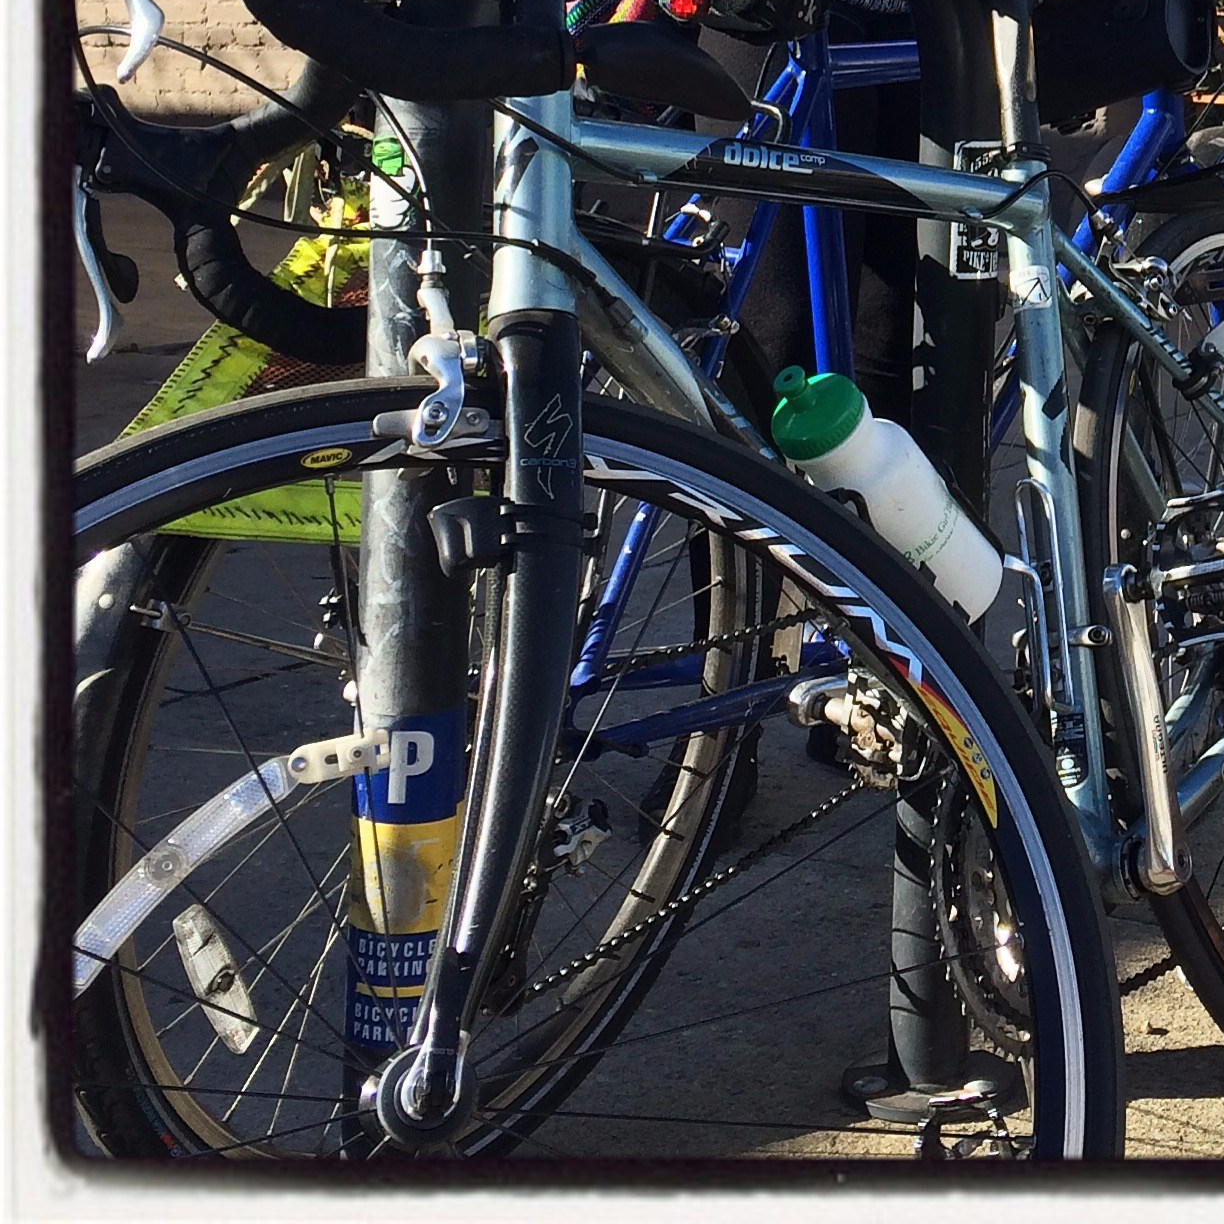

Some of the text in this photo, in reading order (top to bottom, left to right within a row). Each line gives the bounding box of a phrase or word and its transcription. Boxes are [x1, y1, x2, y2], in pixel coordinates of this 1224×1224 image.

[723, 141, 826, 175] dolce comp
[309, 451, 346, 465] MAVIC
[387, 730, 435, 805] P
[358, 938, 438, 958] BICYCLE
[357, 957, 423, 977] PARKIN
[354, 1003, 417, 1023] BICYCL
